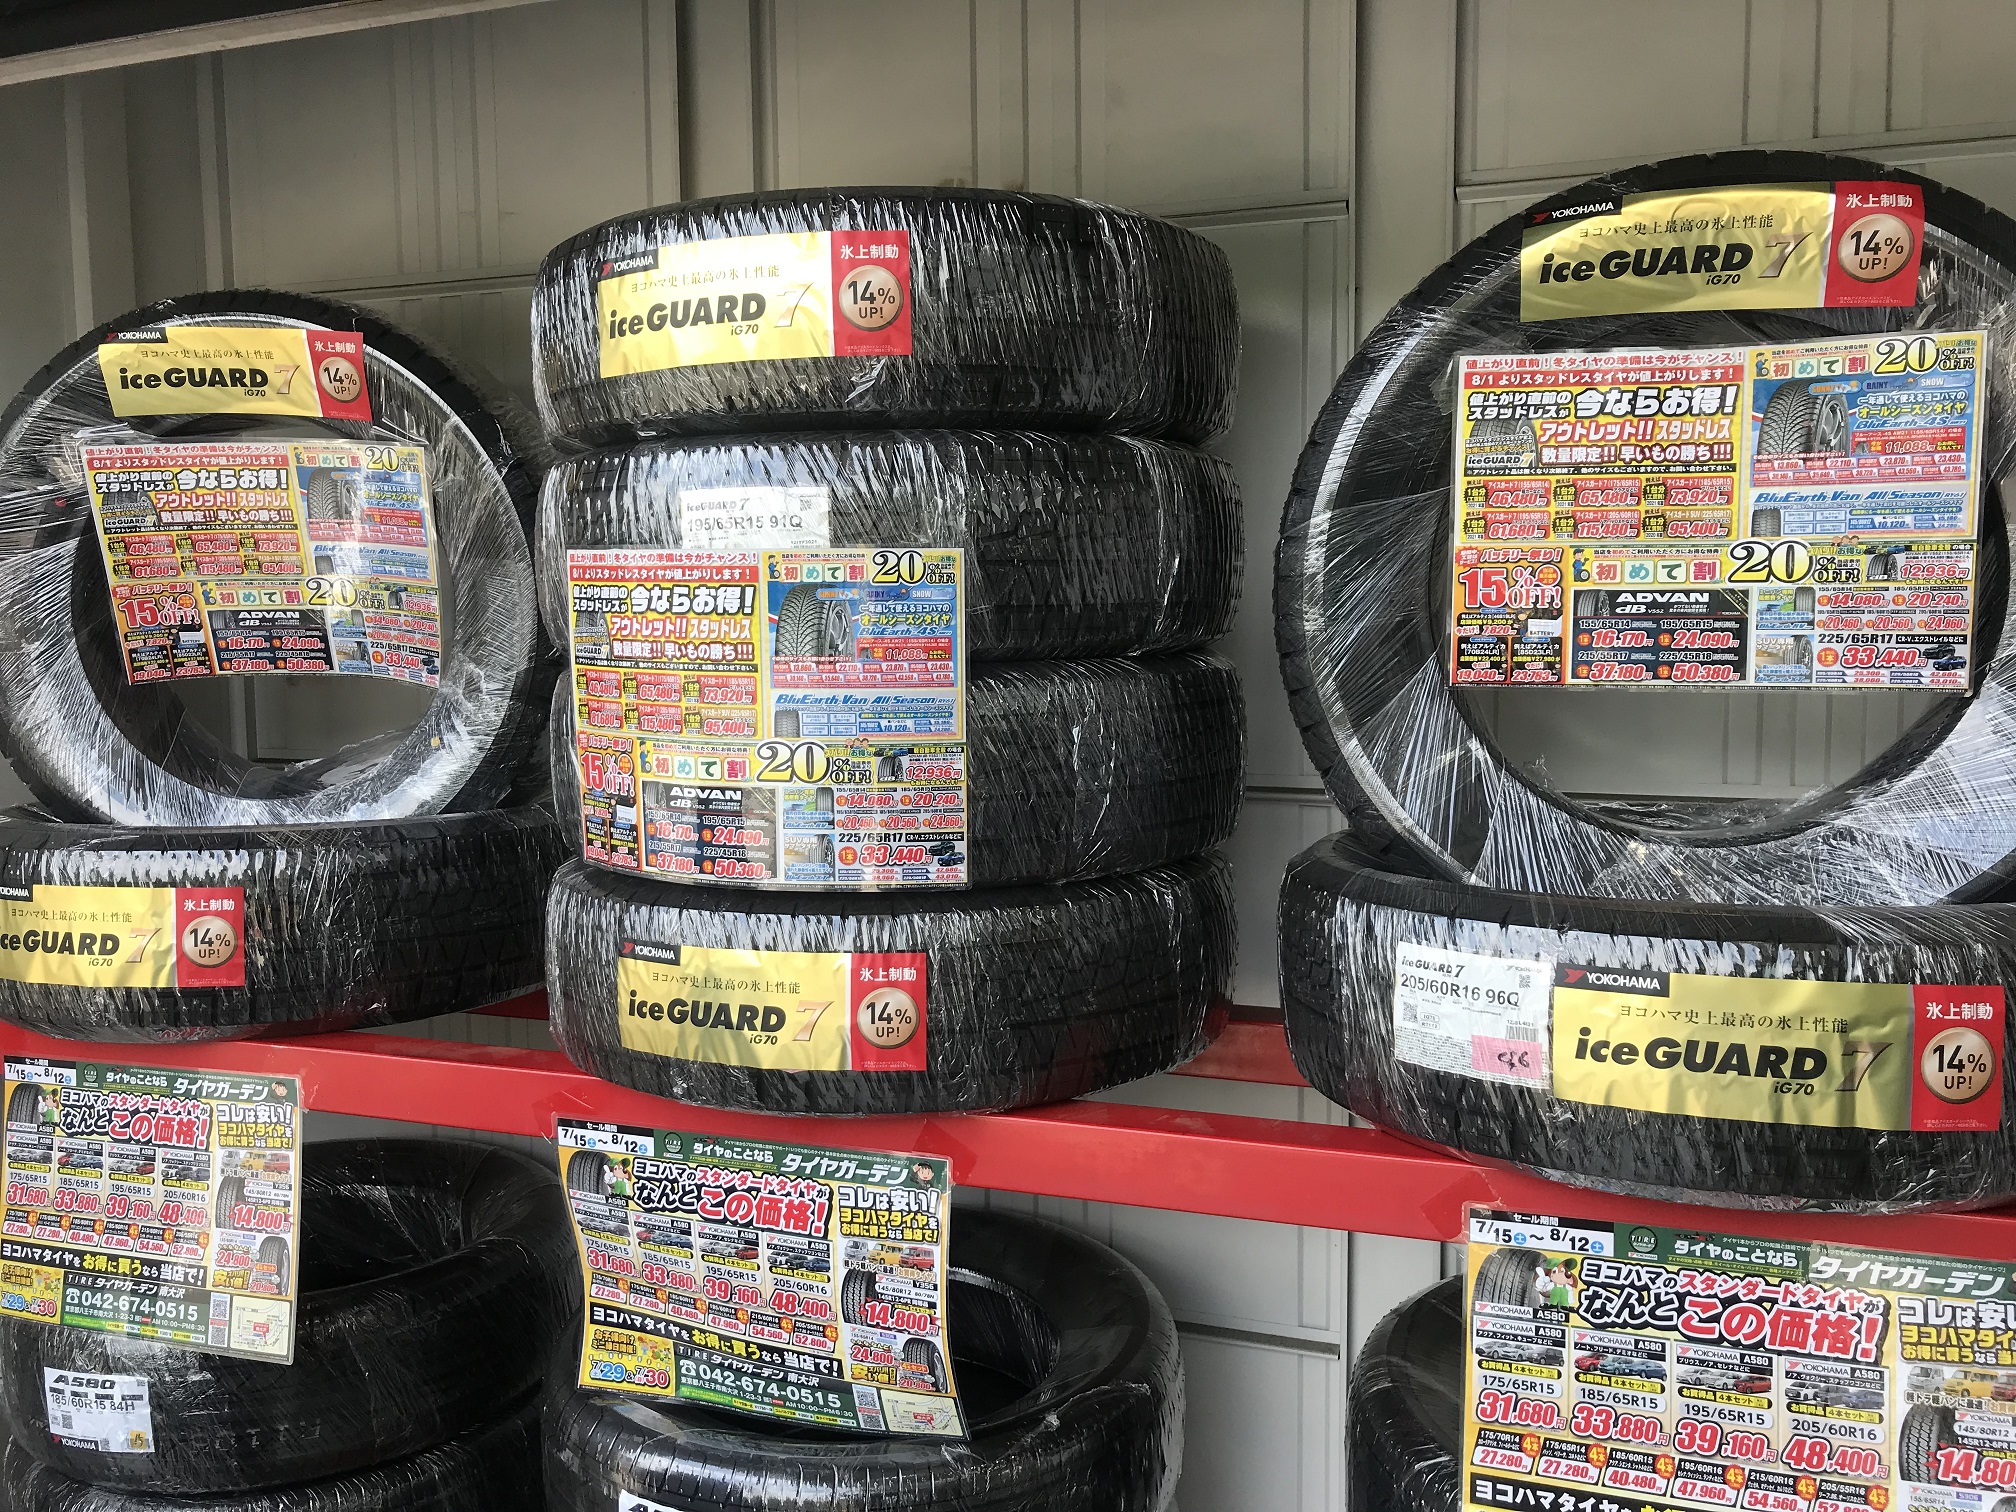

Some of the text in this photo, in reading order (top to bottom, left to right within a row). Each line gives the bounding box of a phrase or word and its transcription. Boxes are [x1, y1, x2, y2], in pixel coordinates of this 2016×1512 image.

[1846, 194, 1912, 208] 氷上制動
[1551, 202, 1614, 219] YOKOHAMA
[1579, 214, 1774, 239] ヨコハマ史上最高の氷上性能
[1850, 230, 1903, 256] 14%
[840, 244, 899, 260] 氷上制動
[1539, 232, 1813, 284] iceGUARD 7
[613, 255, 654, 272] YOKOHAMA
[1859, 257, 1887, 271] UP!
[631, 265, 780, 294] ヨコハマ史上最高の氷上性能
[1706, 274, 1741, 285] iG70
[848, 280, 895, 306] 14%
[609, 292, 766, 340] iceGUARD
[859, 306, 884, 319] UP!
[117, 331, 162, 340] YOKOHAMA
[731, 324, 759, 337] iG70
[140, 348, 274, 360] ヨコハマ史上最高の氷上性能
[314, 340, 356, 354] 氷上制動
[120, 364, 300, 395] iceGUARD 7
[323, 367, 357, 386] 14%
[244, 389, 266, 397] iG70
[333, 386, 351, 395] UP!
[688, 515, 803, 532] 195/65R15 91Q
[1616, 592, 1710, 602] ADVAN
[238, 611, 299, 619] ADVAN
[1818, 634, 1894, 644] 225/65R17
[670, 787, 742, 800] ADVAN
[839, 833, 903, 842] 225/65R17
[0, 887, 29, 897] OKOHAMA
[184, 899, 235, 911] 氷上制動
[11, 909, 132, 923] ヨコハマ史上最高の氷上性能
[0, 927, 162, 963] ceGUARD 7
[189, 927, 231, 948] 14%
[198, 948, 220, 959] UP!
[634, 945, 675, 960] YOKOHAMA
[88, 958, 113, 966] iG70
[652, 971, 800, 994] ヨコハマ史上最高の氷上性能
[859, 967, 916, 982] 氷上制動
[1587, 972, 1661, 991] YOKOHAMA
[1401, 973, 1520, 1007] 205/60R16 96Q
[628, 989, 834, 1042] iceGUARD 7
[866, 1002, 912, 1025] 14%
[1926, 1001, 1993, 1020] 氷上制動
[1619, 1006, 1849, 1034] ヨコハマ史上最高の氷上性能
[750, 1034, 778, 1045] iG70
[876, 1026, 900, 1038] UP!
[1574, 1027, 1828, 1082] iceGUARD
[1834, 1043, 1895, 1092] 7
[1931, 1044, 1987, 1073] 14%
[173, 1079, 269, 1100] タイヤガーデン
[1773, 1080, 1815, 1097] iG70
[1944, 1075, 1973, 1090] UP!
[781, 1154, 908, 1184] タイヤガーデン
[1809, 1257, 2005, 1296] タイヤガーデン
[773, 1278, 828, 1295] 205/60R16
[82, 1290, 198, 1321] 042-674-0515
[1489, 1304, 1565, 1321] YOKOHAMA A580
[1491, 1321, 1662, 1351] YOKOHAMA A580 YOKOHAMA A580
[1693, 1348, 1769, 1365] YOKOHAMA A580
[1801, 1362, 1880, 1380] YOKOHAMA A580
[698, 1365, 841, 1408] 042-674-0515
[1482, 1374, 1658, 1410] 175/65R15 185/65R15
[51, 1393, 135, 1412] 185/60R15 84H
[1685, 1403, 1765, 1425] 195/65R15
[1792, 1418, 1877, 1441] 205/60R16
[62, 1438, 95, 1450] YOKOHAMA
